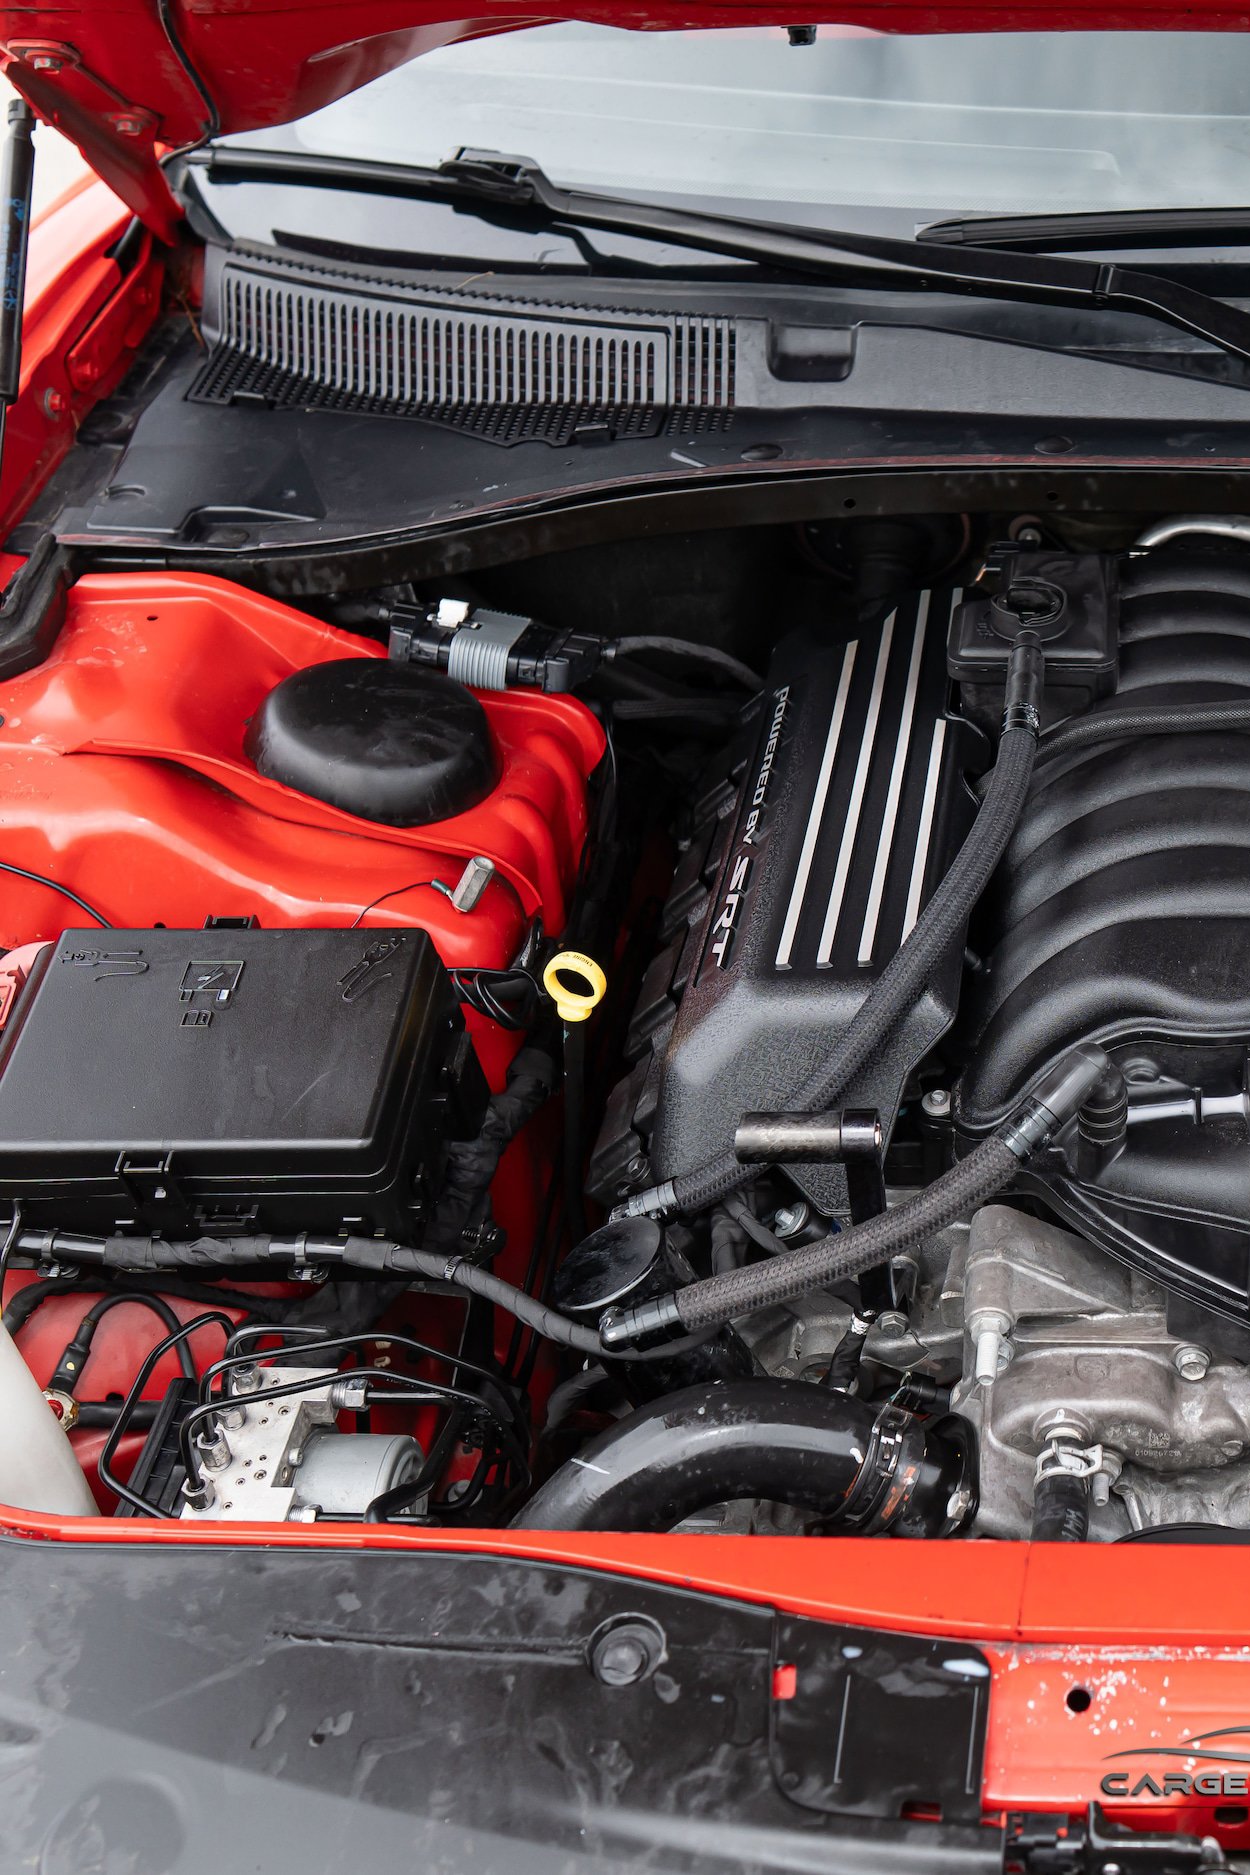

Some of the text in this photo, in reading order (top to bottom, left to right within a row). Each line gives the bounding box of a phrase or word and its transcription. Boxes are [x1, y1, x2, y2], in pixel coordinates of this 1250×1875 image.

[712, 685, 790, 969] POWERED BY SRT
